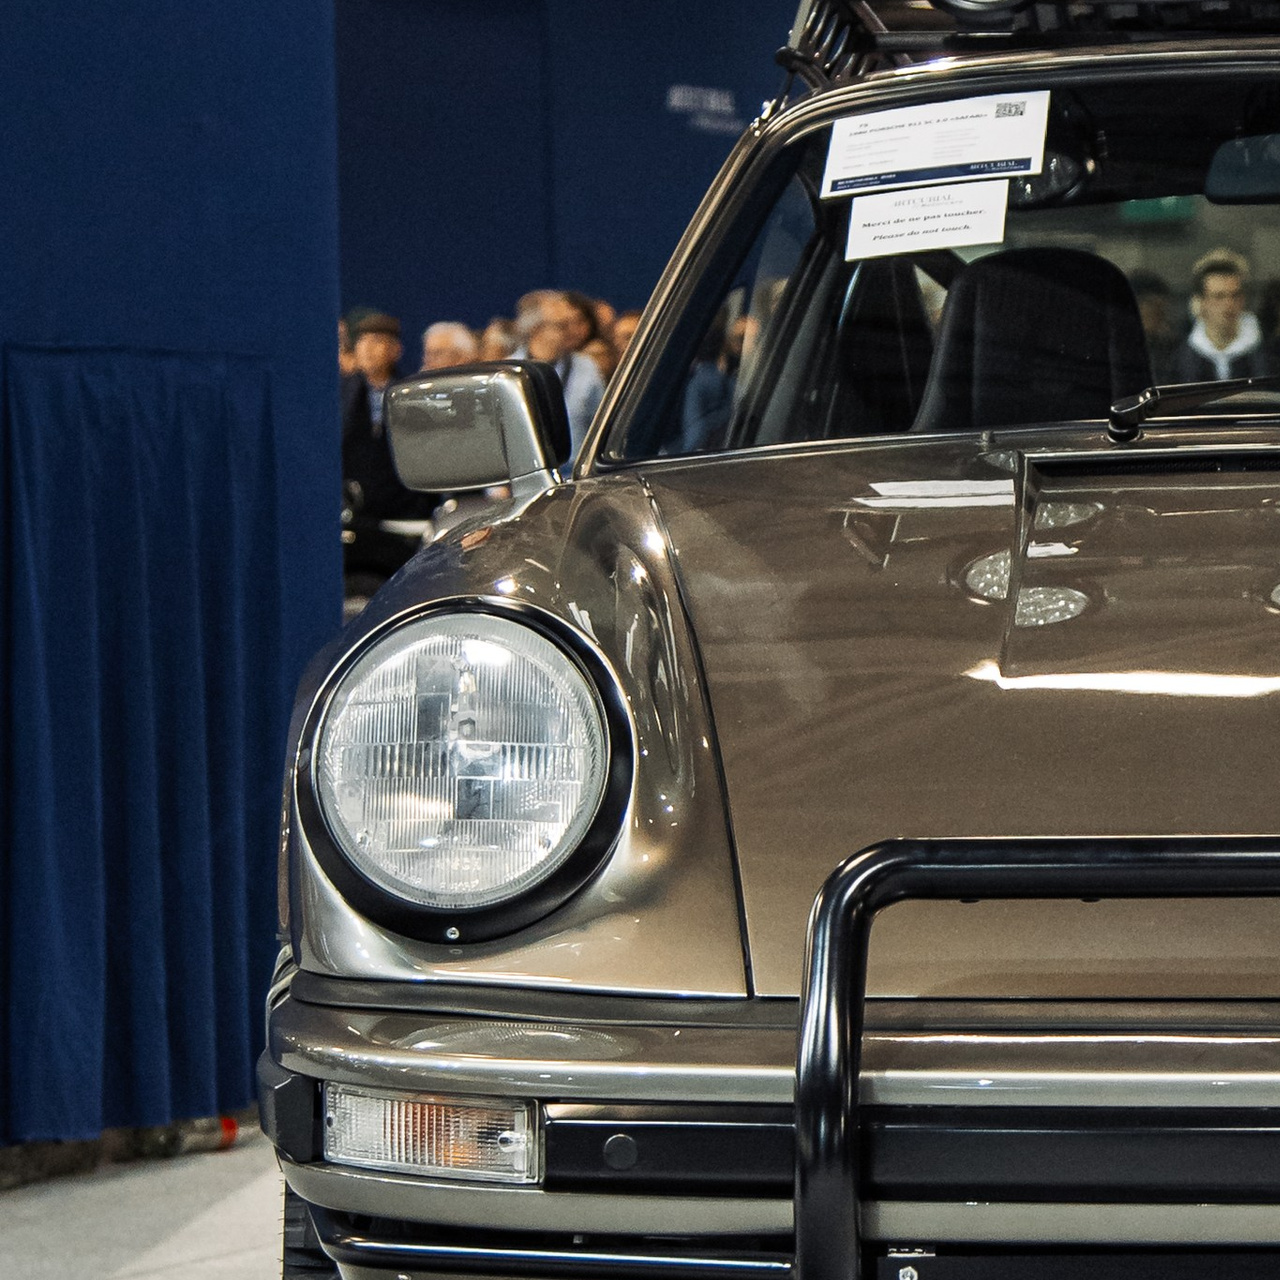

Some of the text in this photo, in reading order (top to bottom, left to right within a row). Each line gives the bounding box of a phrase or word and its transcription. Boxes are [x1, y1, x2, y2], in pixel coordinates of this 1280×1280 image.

[861, 219, 891, 228] Merci
[924, 213, 942, 222] pas
[944, 209, 987, 218] toucher.
[872, 232, 906, 241] Please
[922, 227, 939, 235] not
[941, 223, 972, 233] touch.
